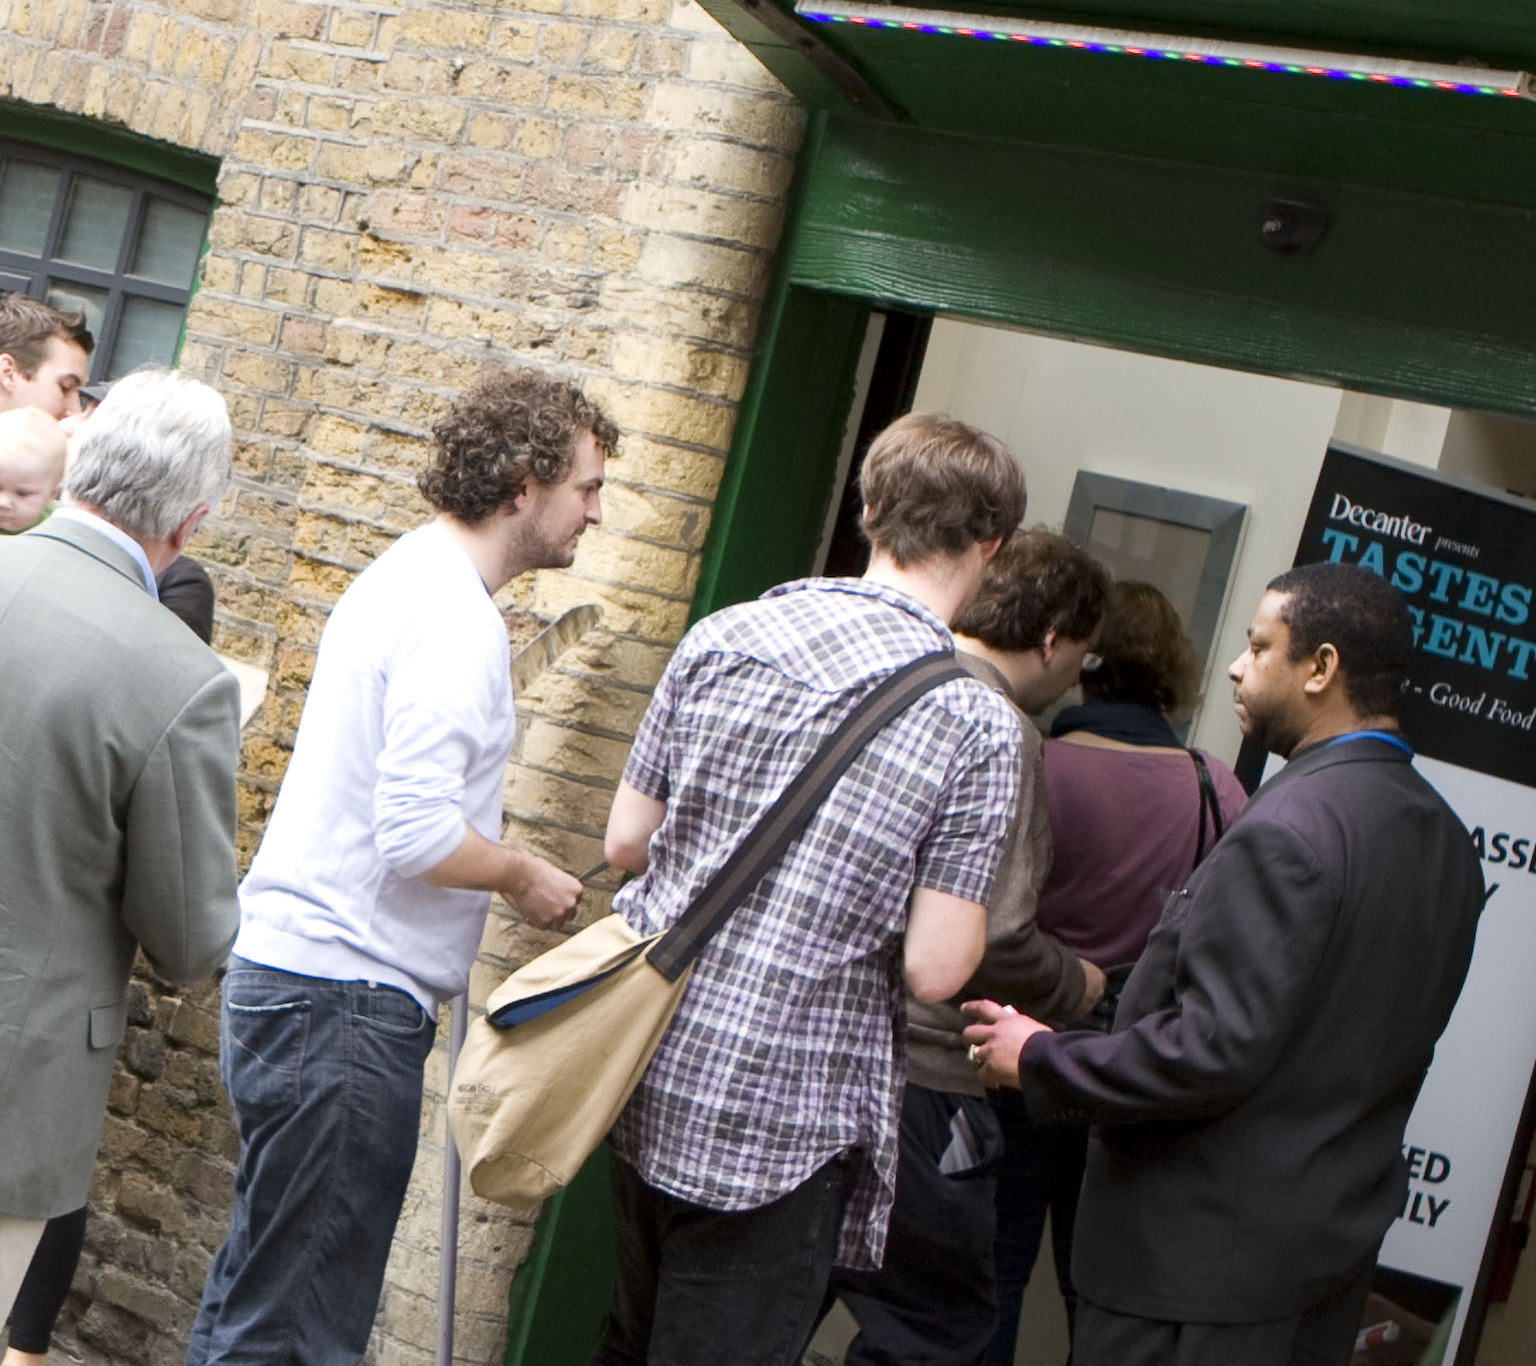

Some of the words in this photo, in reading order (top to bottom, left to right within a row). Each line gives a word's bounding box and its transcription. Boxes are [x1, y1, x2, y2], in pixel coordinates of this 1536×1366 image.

[1329, 492, 1433, 546] Decanter
[1434, 536, 1481, 558] presents
[1322, 528, 1533, 626] TASTES
[1430, 682, 1486, 715] Good
